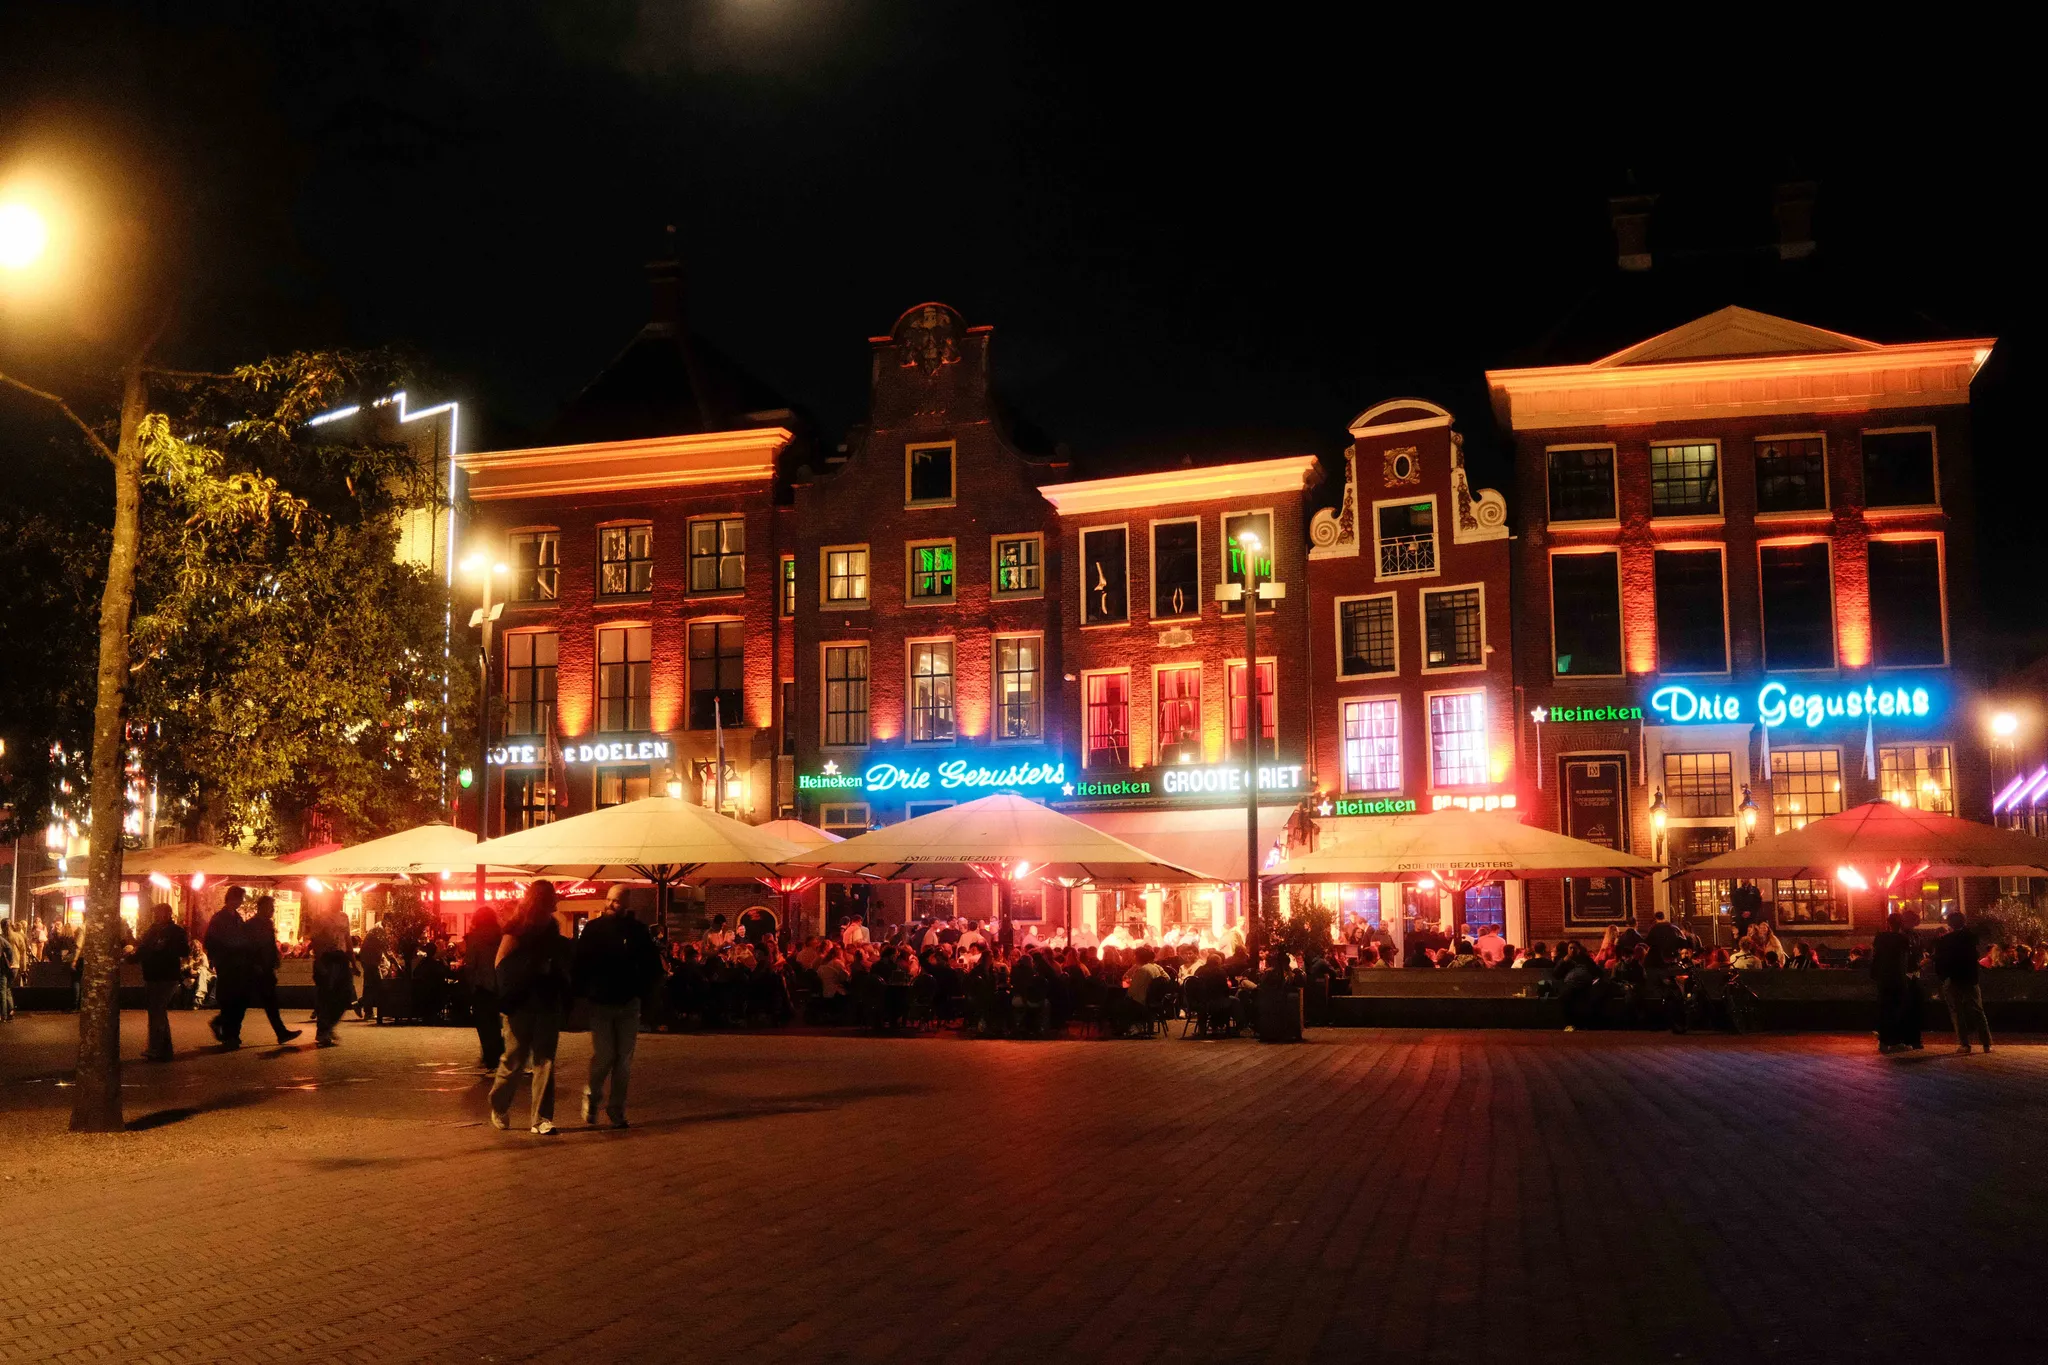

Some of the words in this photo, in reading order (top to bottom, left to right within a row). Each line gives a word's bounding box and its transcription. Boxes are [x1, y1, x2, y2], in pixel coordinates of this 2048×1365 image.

[1652, 686, 1741, 722] Drie
[1550, 706, 1642, 722] Heineken
[579, 741, 669, 762] DOELEN
[799, 775, 863, 788] Heineken
[866, 763, 931, 791] Drie
[938, 759, 1065, 789] Gezusters
[1163, 769, 1241, 793] GROOTE
[1245, 766, 1302, 789] RIET
[1077, 781, 1151, 795] Heineken
[1335, 798, 1417, 816] Heineken
[1450, 861, 1514, 869] GEZUSTERS
